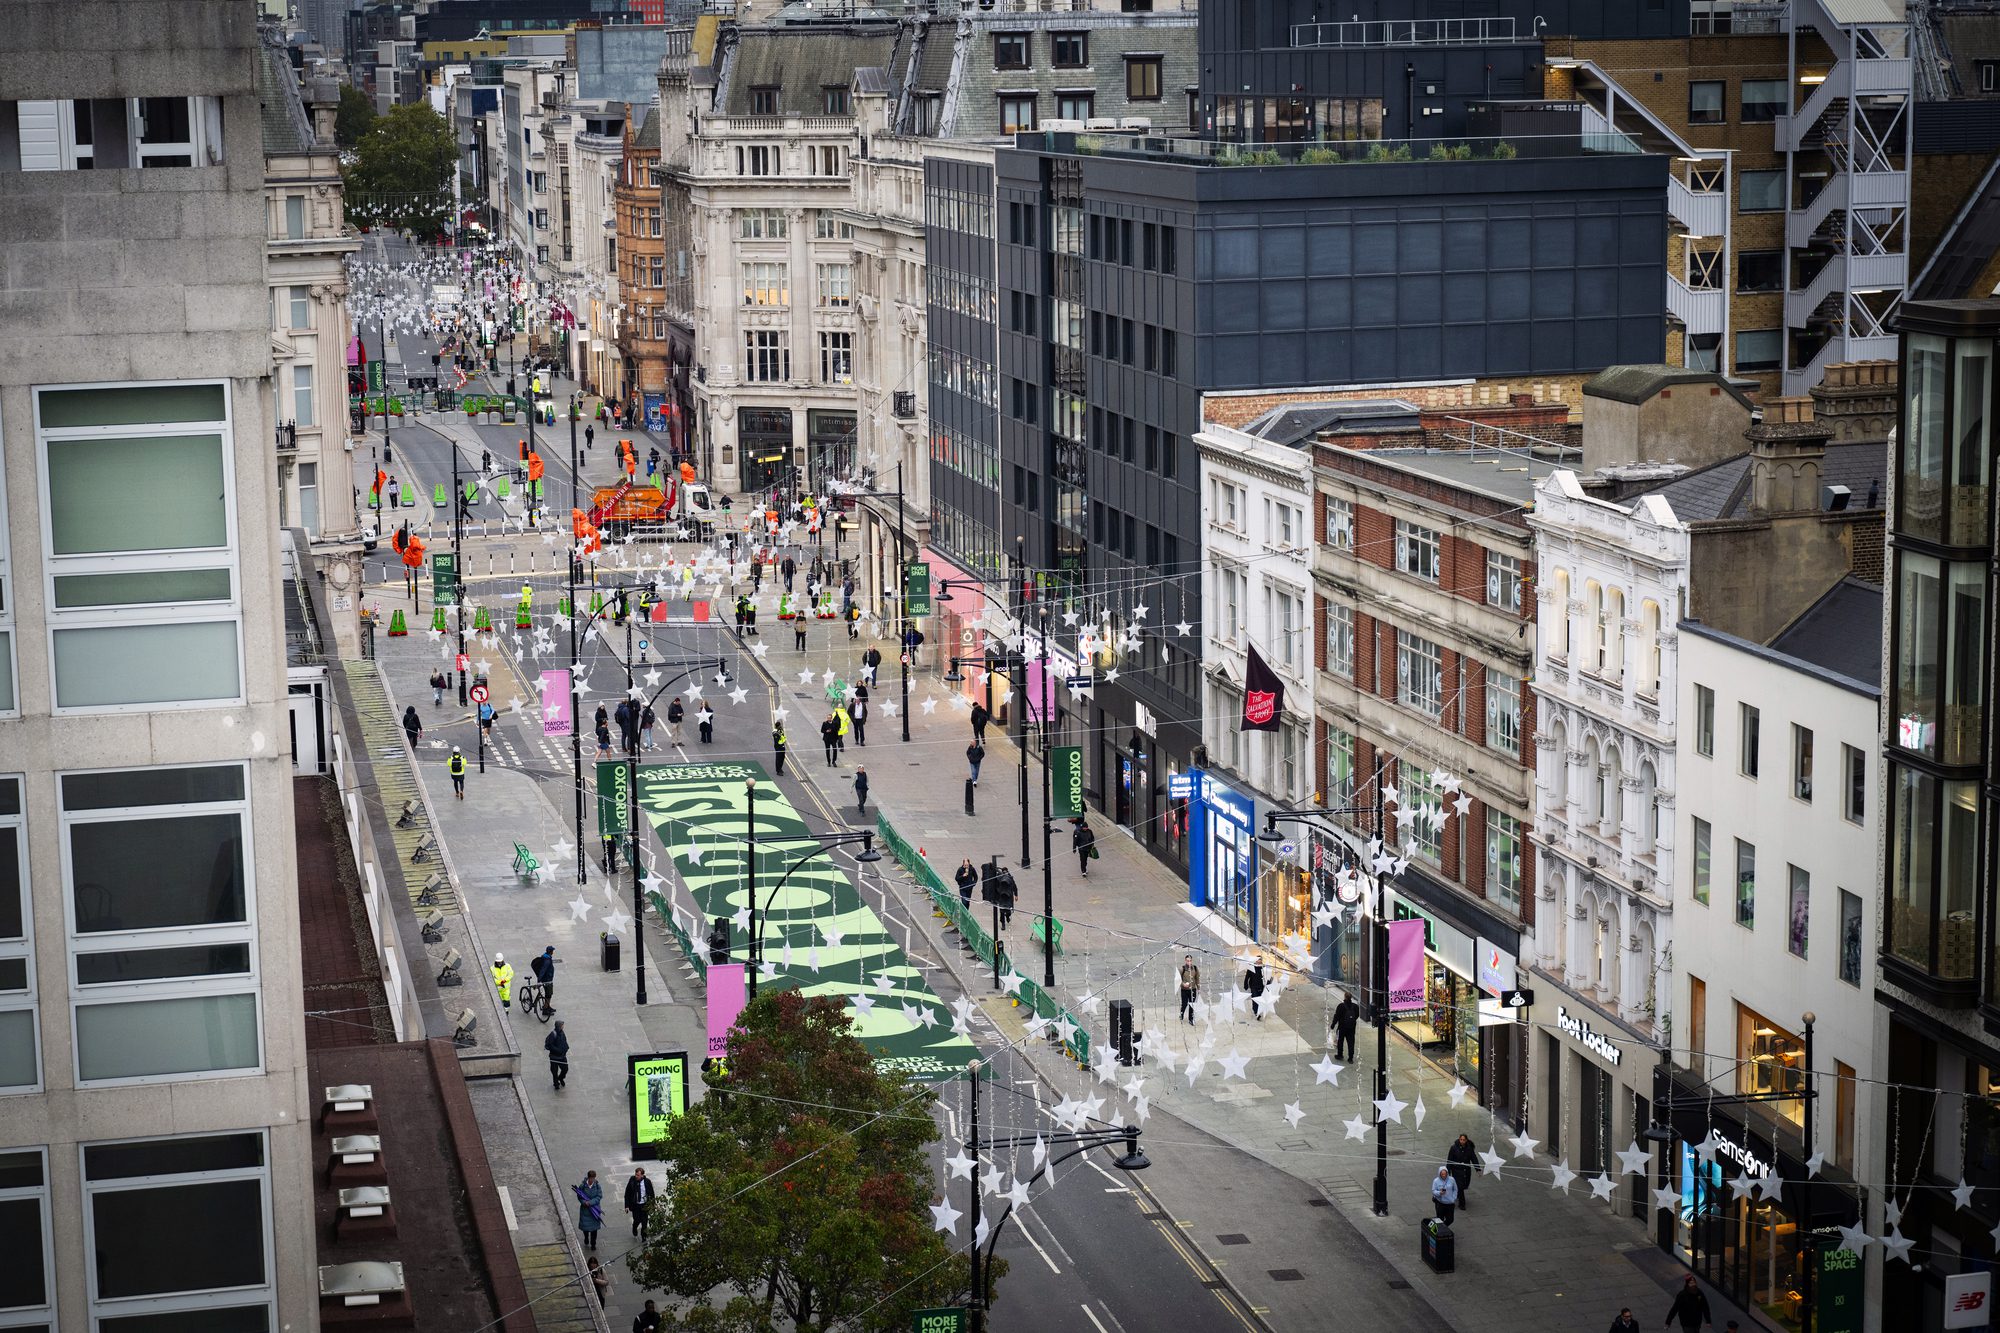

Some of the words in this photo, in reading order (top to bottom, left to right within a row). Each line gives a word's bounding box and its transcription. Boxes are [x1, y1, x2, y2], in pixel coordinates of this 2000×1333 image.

[614, 485, 629, 500] HIRE
[1252, 694, 1262, 703] THE
[1247, 699, 1272, 713] SALVATION
[1254, 707, 1271, 719] ARMY
[1069, 751, 1082, 803] OXFORD
[1172, 776, 1191, 785] atm
[614, 765, 627, 819] OXFORD
[1390, 989, 1416, 997] MAYOR
[1390, 995, 1423, 1004] LONDON
[1558, 1006, 1581, 1040] Foot
[1583, 1022, 1621, 1065] Locker
[637, 1064, 680, 1076] COMING
[1824, 1249, 1857, 1260] MORE
[1824, 1259, 1857, 1271] SPACE
[921, 1315, 958, 1328] MORE
